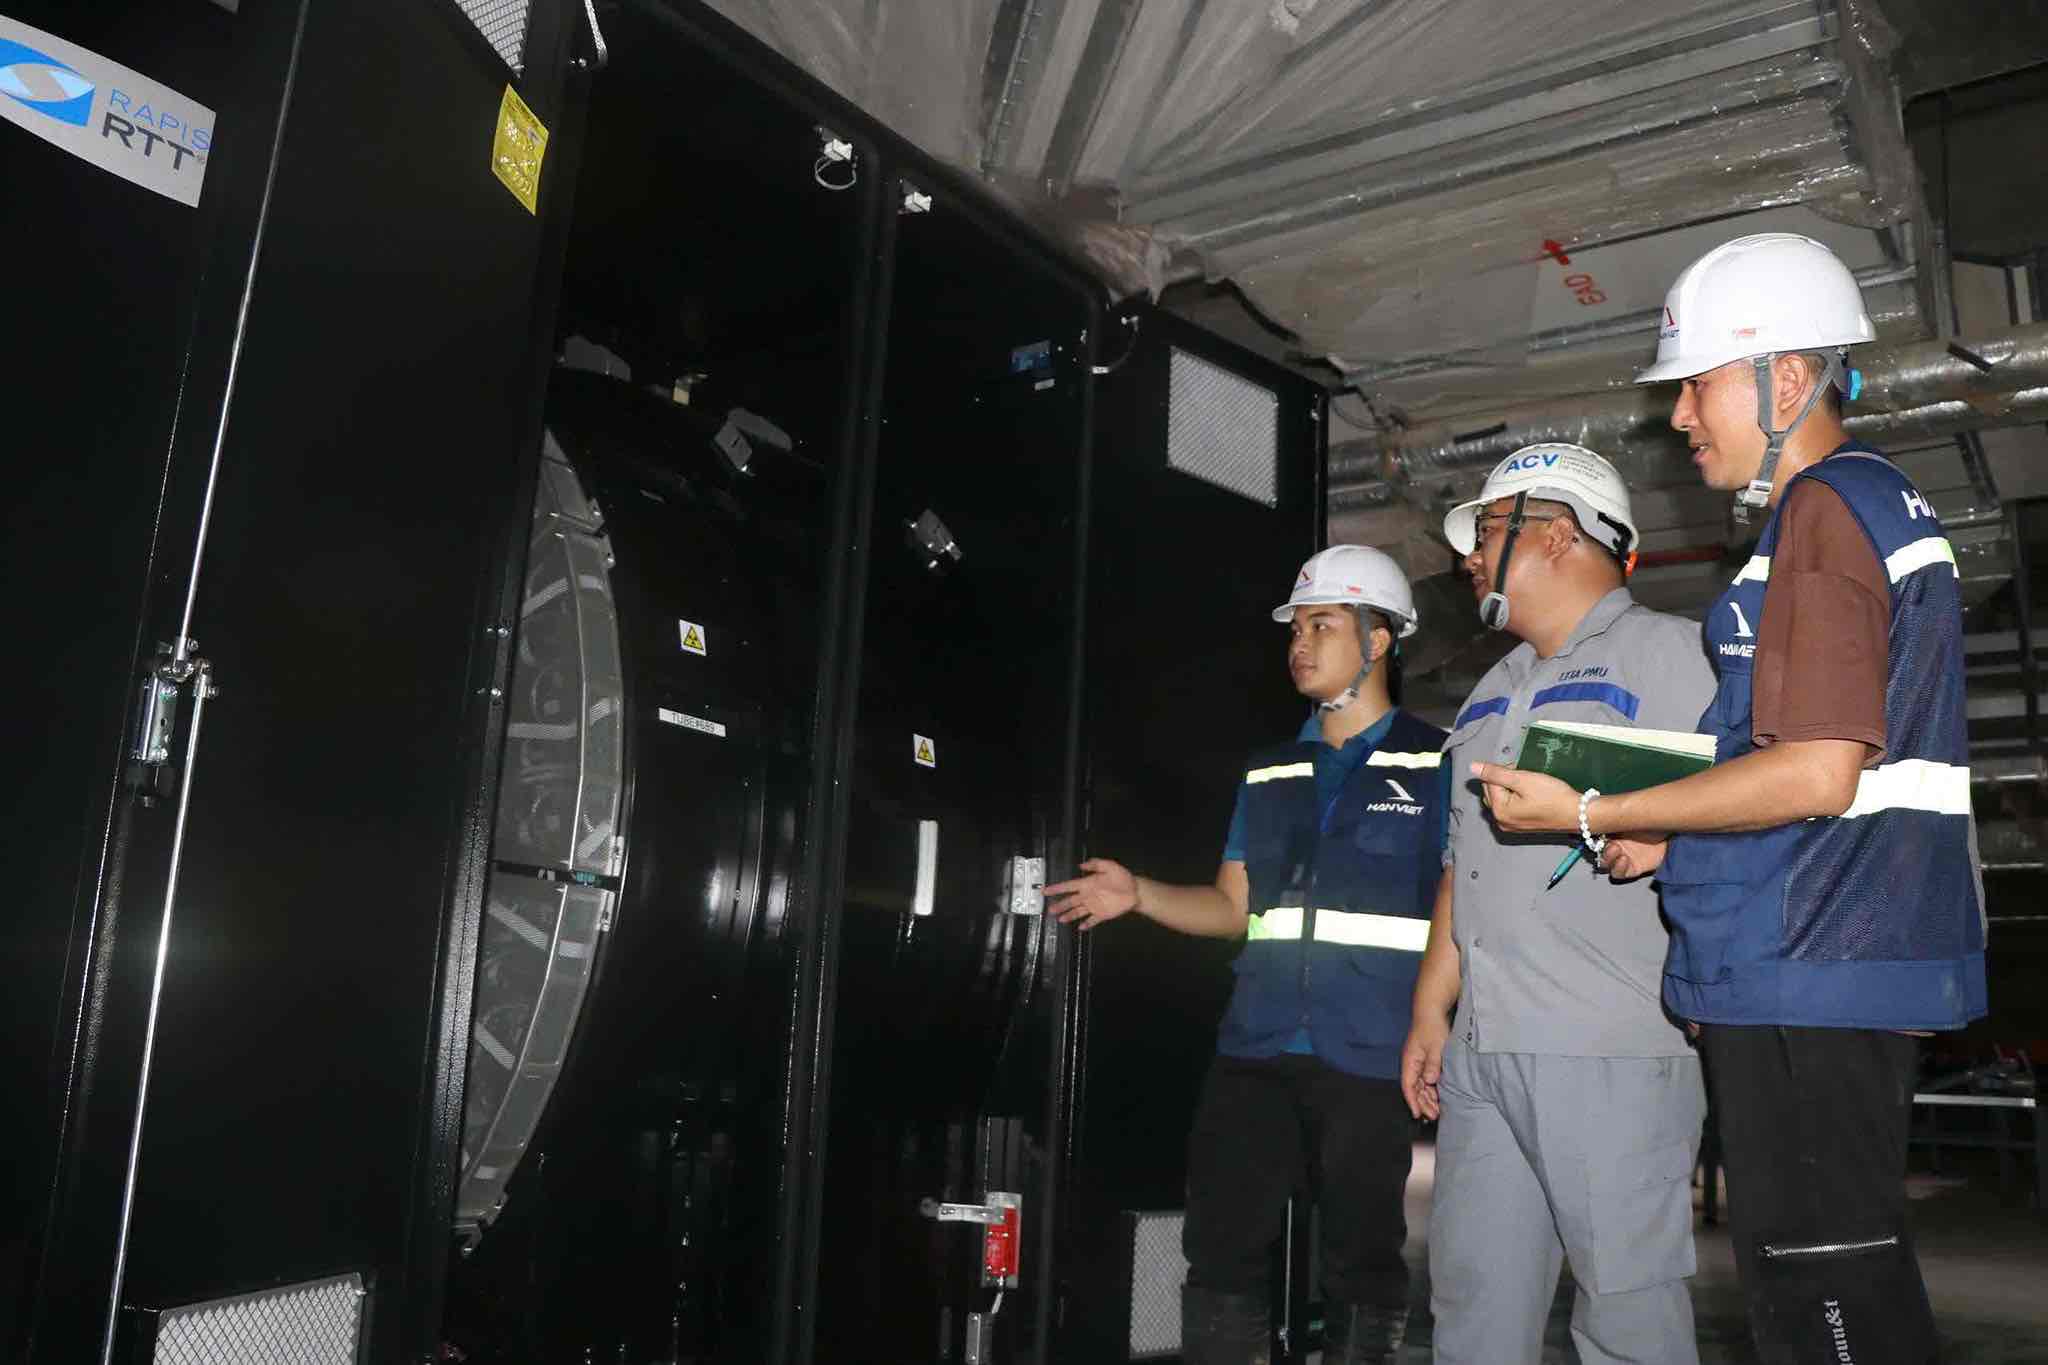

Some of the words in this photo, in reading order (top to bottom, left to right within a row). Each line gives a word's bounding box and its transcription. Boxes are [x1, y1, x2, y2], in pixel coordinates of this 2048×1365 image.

[102, 112, 196, 171] RTT
[1504, 454, 1559, 474] ACV
[1366, 803, 1425, 815] HANVIET
